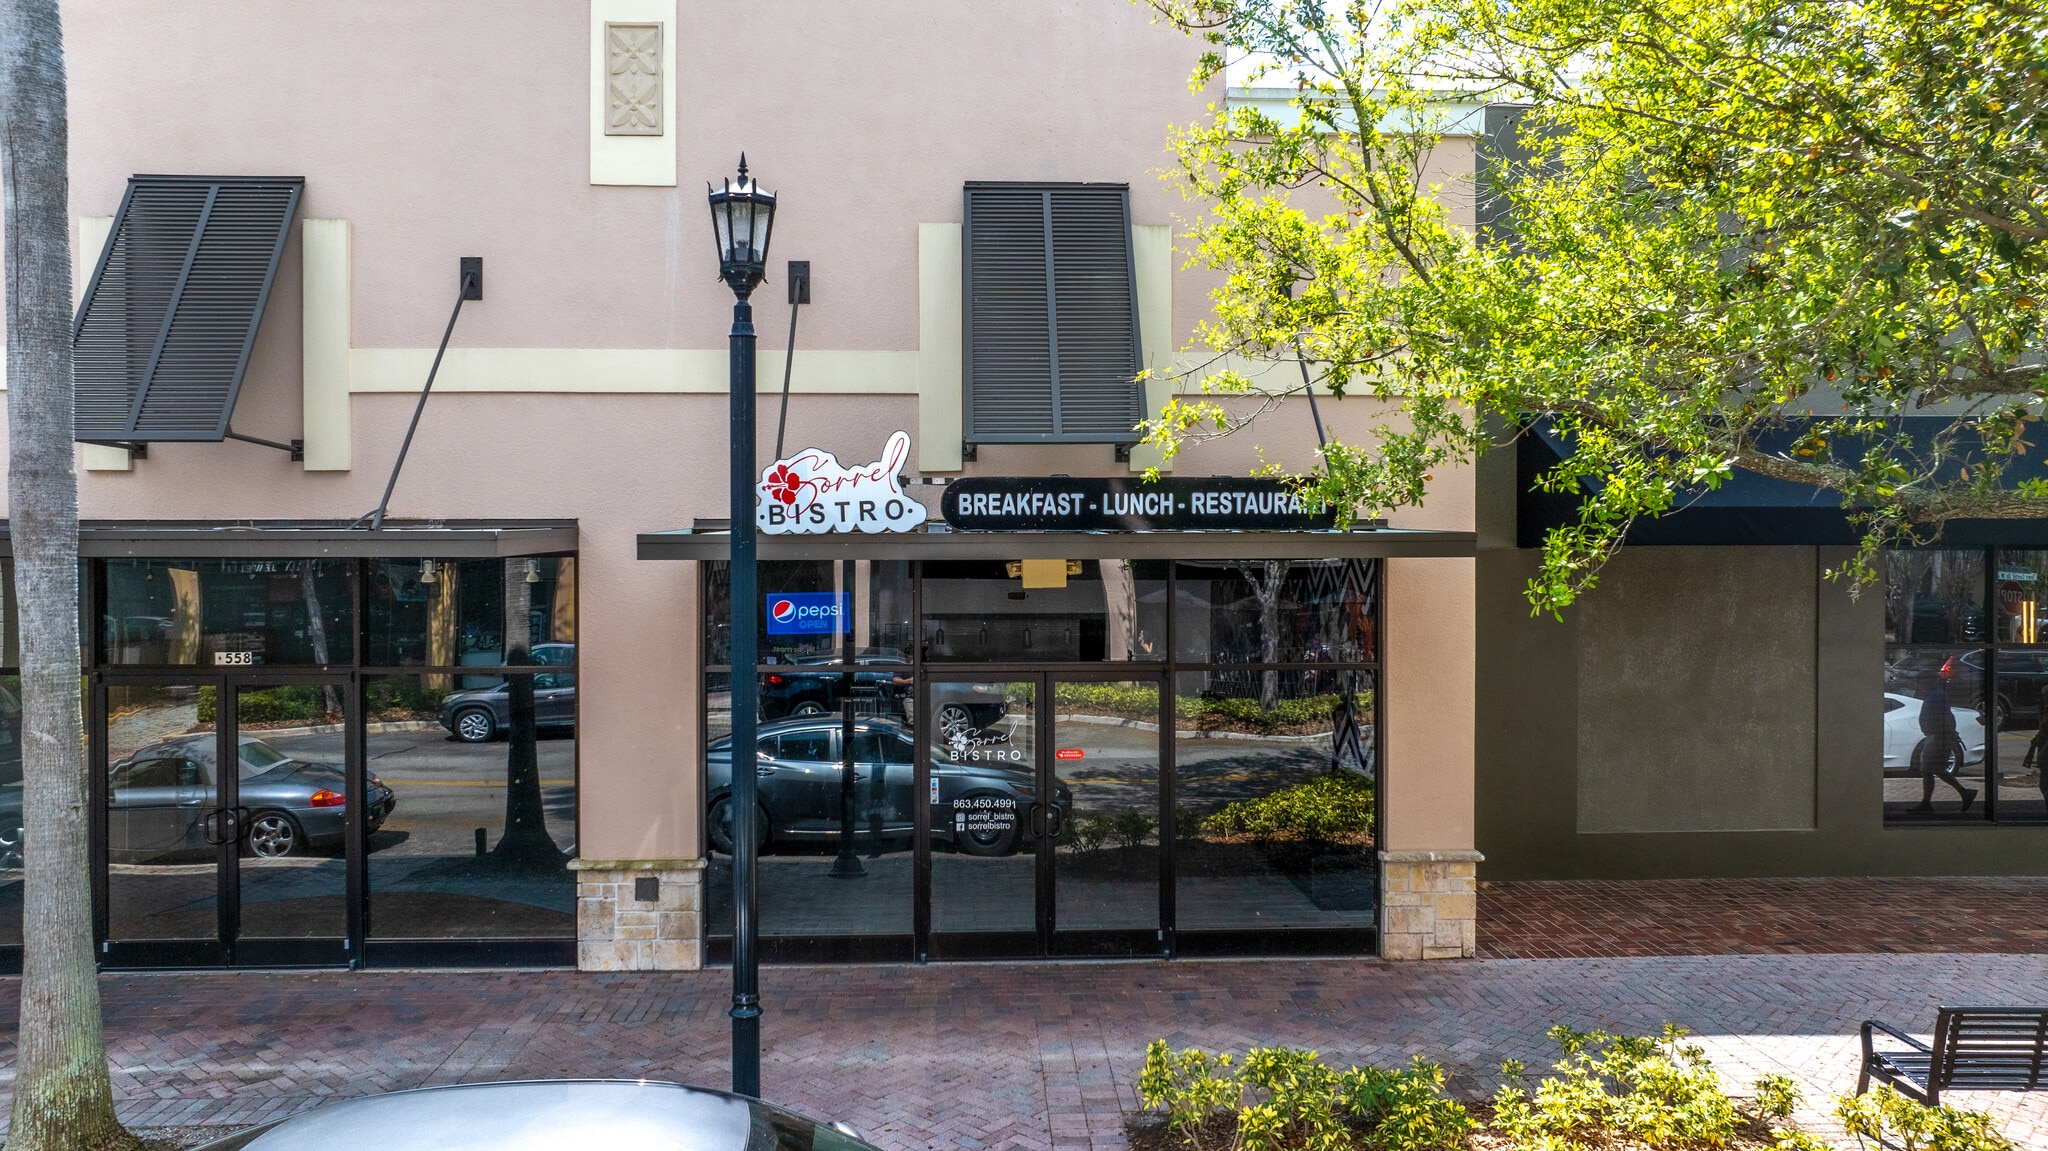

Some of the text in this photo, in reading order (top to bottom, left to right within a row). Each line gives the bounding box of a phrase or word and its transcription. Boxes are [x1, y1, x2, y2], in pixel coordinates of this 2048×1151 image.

[787, 437, 905, 518] Sorrel
[958, 492, 1084, 516] BREAKFAST
[1103, 492, 1173, 516] LUNCH
[1191, 492, 1326, 515] RESTAURA
[768, 499, 904, 526] BISTRO
[798, 602, 843, 620] pepsi
[799, 620, 828, 629] OPEN
[225, 652, 251, 664] 558
[960, 721, 1018, 758] Sorrel
[950, 749, 1022, 761] BISTRO
[953, 798, 1017, 810] 863.450.4991
[967, 812, 1015, 822] sorrel_bistro
[967, 821, 1011, 831] sorrelbistro
